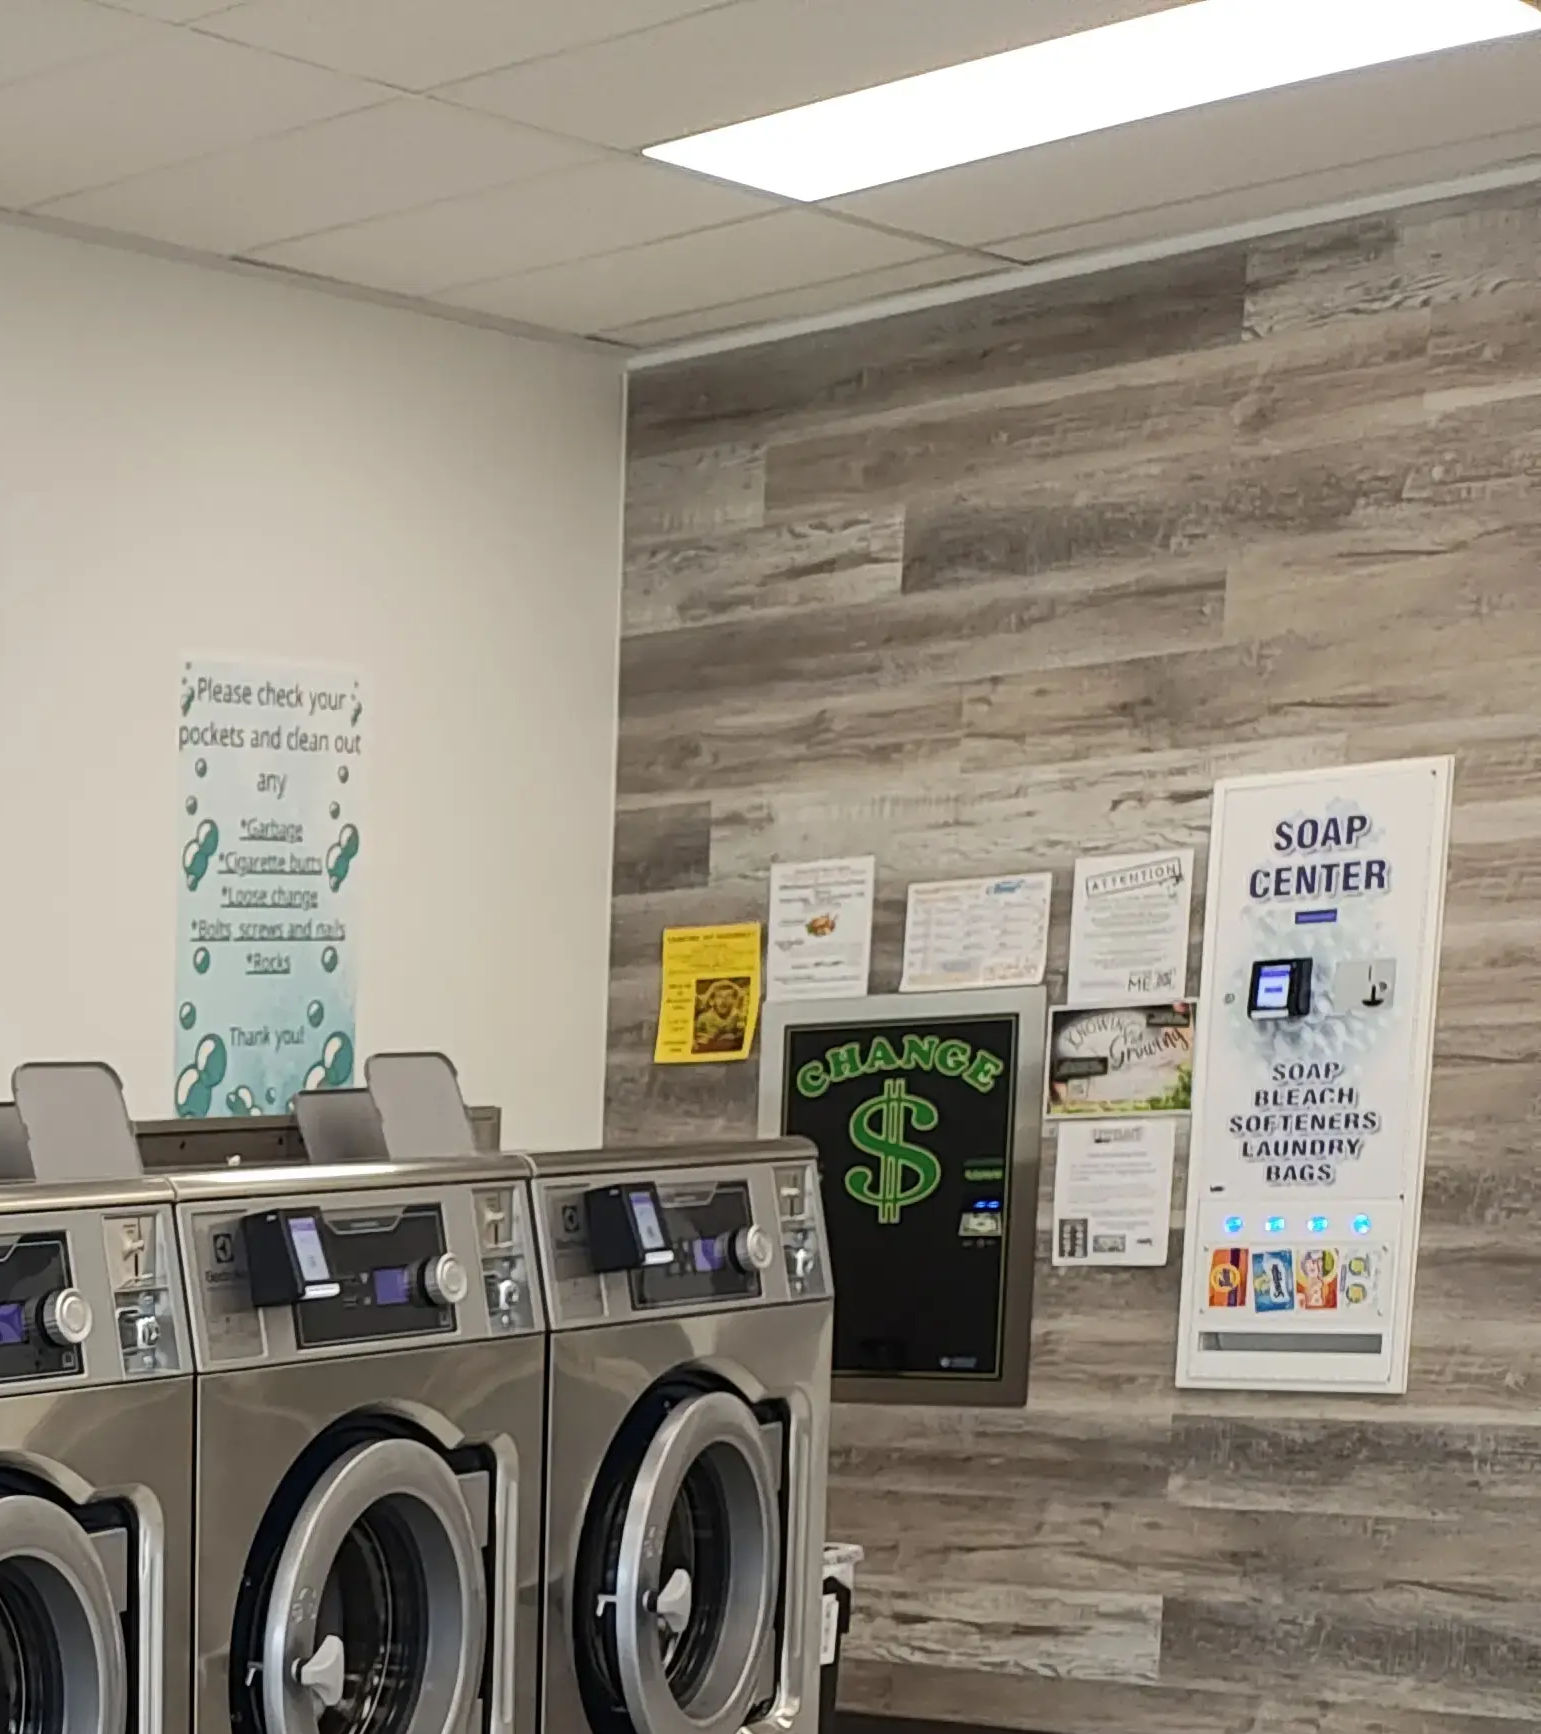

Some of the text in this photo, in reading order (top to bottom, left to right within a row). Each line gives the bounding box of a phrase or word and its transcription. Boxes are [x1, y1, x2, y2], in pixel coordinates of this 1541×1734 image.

[197, 676, 346, 716] Please check your
[178, 721, 361, 755] pockets and clean out
[256, 771, 288, 800] any
[1273, 814, 1369, 851] SOAP
[1091, 863, 1176, 892] ATTENTION
[1249, 859, 1387, 899] CENTER
[271, 887, 319, 909] change
[239, 922, 284, 938] screws
[287, 920, 312, 938] and
[229, 1027, 306, 1051] Thank you!
[1109, 1027, 1189, 1072] Growing
[797, 1034, 1004, 1098] CHANGE
[1272, 1061, 1341, 1082] SOAP
[1254, 1087, 1355, 1107] BLEACH
[1229, 1111, 1378, 1133] SOFTENERS
[1242, 1138, 1361, 1158] LAUNDRY
[1266, 1163, 1332, 1182] BAGS
